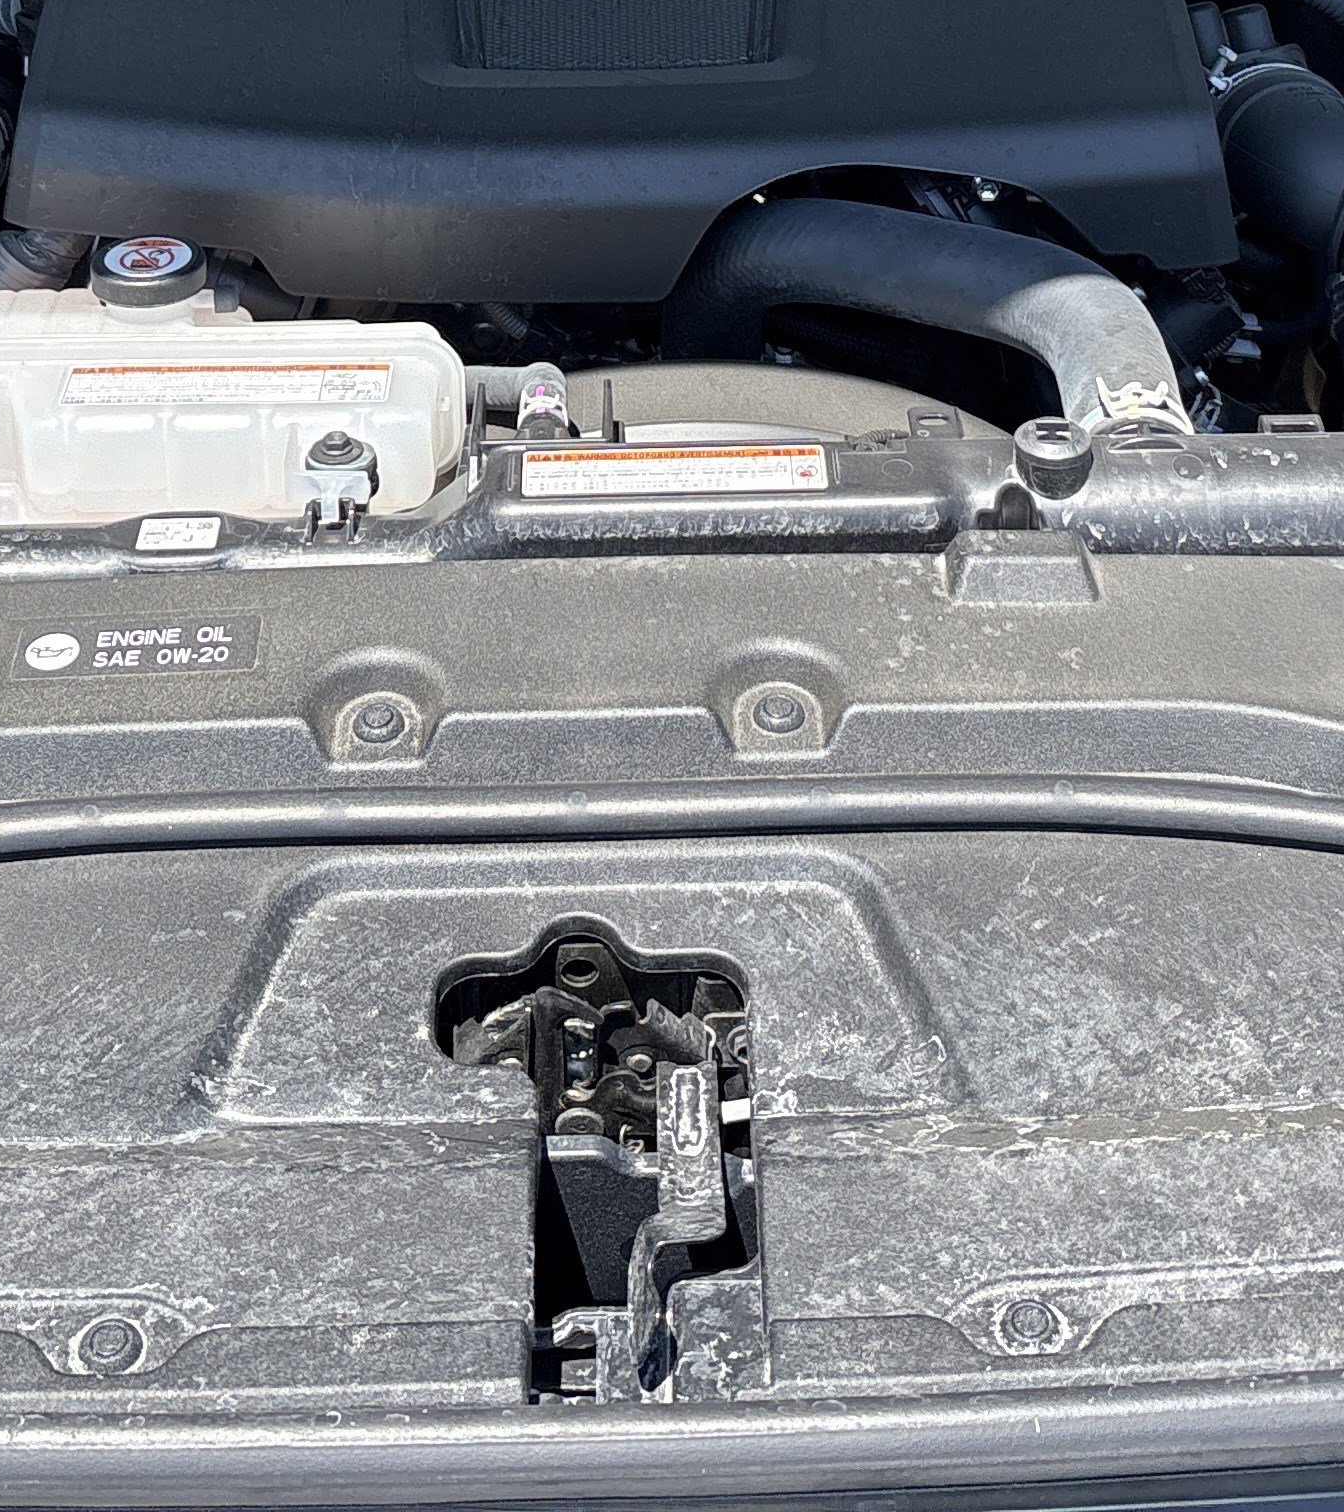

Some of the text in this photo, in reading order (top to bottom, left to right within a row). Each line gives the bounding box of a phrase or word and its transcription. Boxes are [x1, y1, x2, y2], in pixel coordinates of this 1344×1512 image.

[577, 452, 617, 461] WARNING
[96, 626, 233, 647] ENGINE OIL
[92, 646, 230, 668] SAE 0W-20
